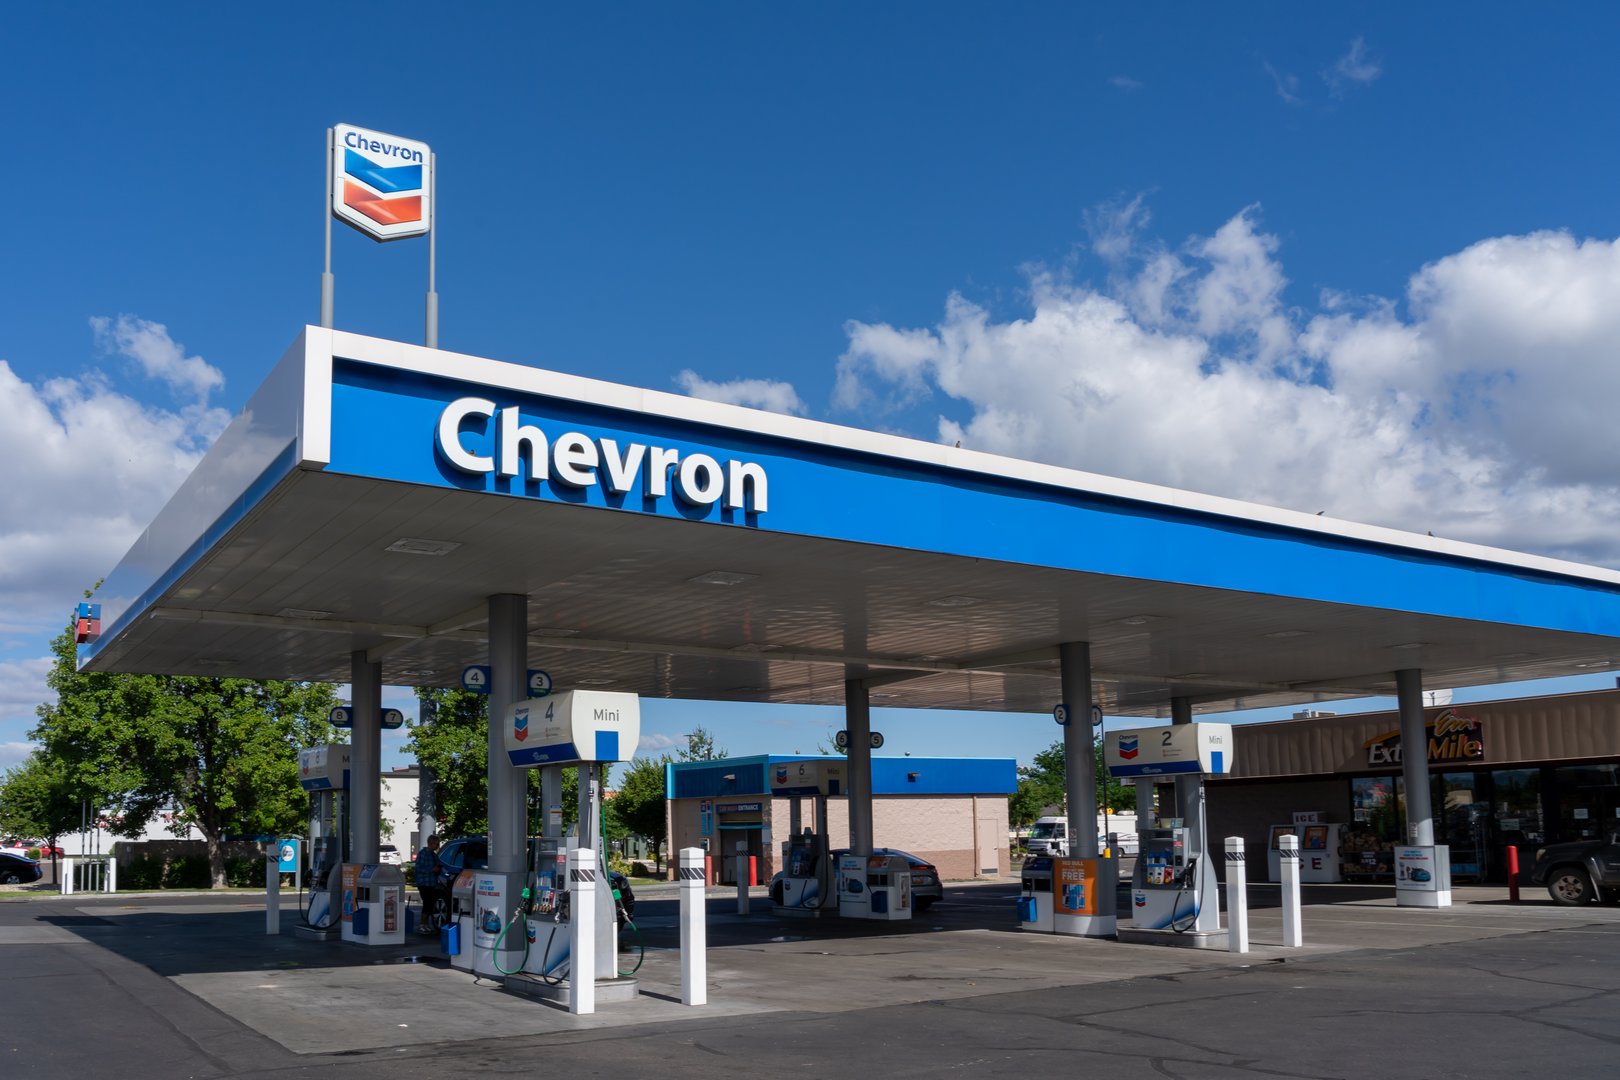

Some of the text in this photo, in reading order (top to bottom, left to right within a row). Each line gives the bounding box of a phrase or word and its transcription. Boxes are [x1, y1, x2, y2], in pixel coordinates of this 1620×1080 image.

[344, 131, 424, 163] Chevron
[436, 396, 768, 514] Chevron
[470, 672, 480, 682] 4
[535, 676, 544, 687] 3
[335, 711, 343, 720] 8
[389, 713, 397, 722] 7
[545, 701, 554, 723] 4
[593, 708, 620, 722] Mini
[1056, 709, 1065, 721] 2
[1161, 730, 1172, 746] 2
[1208, 735, 1223, 745] Mini
[1295, 814, 1316, 823] ICE
[1062, 871, 1085, 881] FREE
